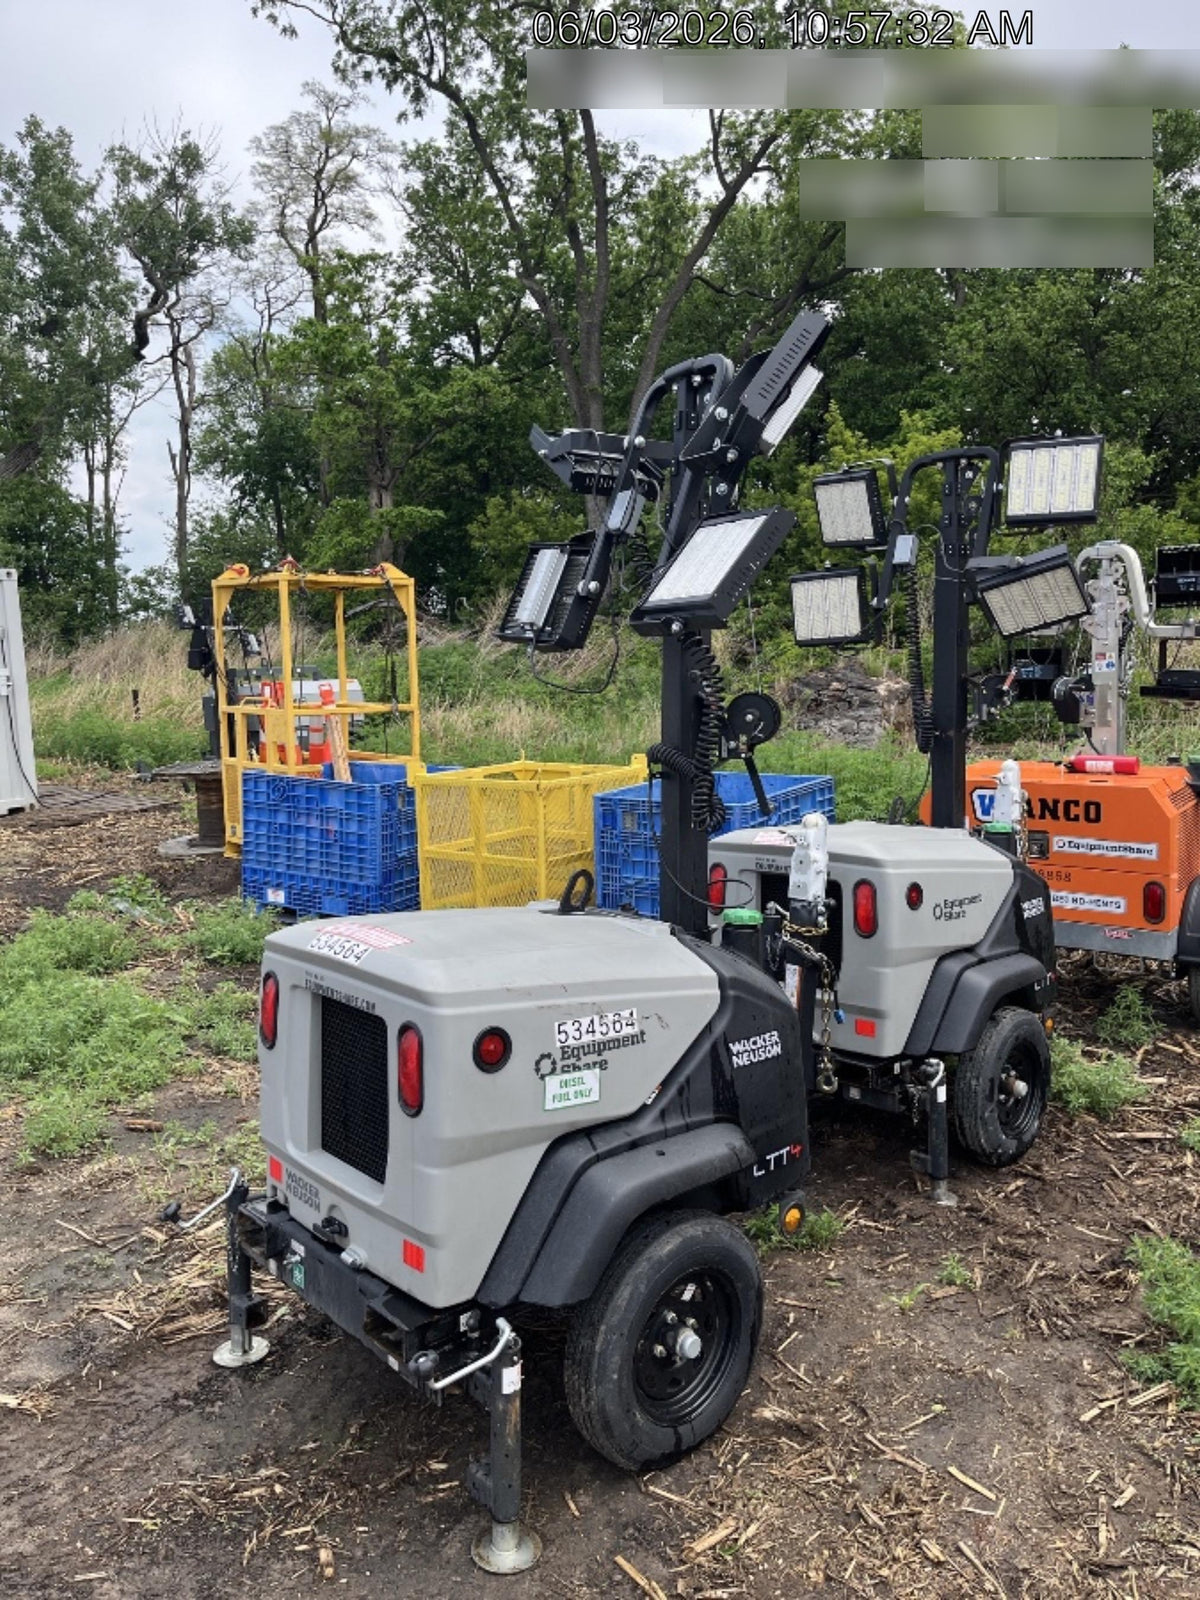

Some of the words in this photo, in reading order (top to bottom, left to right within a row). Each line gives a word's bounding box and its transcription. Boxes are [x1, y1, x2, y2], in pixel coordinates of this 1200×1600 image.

[310, 935, 370, 962] 534564
[556, 1009, 637, 1045] 534564
[559, 1029, 647, 1062] Equipment
[728, 1030, 780, 1055] WACKER
[731, 1042, 782, 1069] NEUSON
[552, 1091, 571, 1104] FUEL
[573, 1087, 593, 1100] ONLY
[559, 1076, 586, 1089] DIESEL
